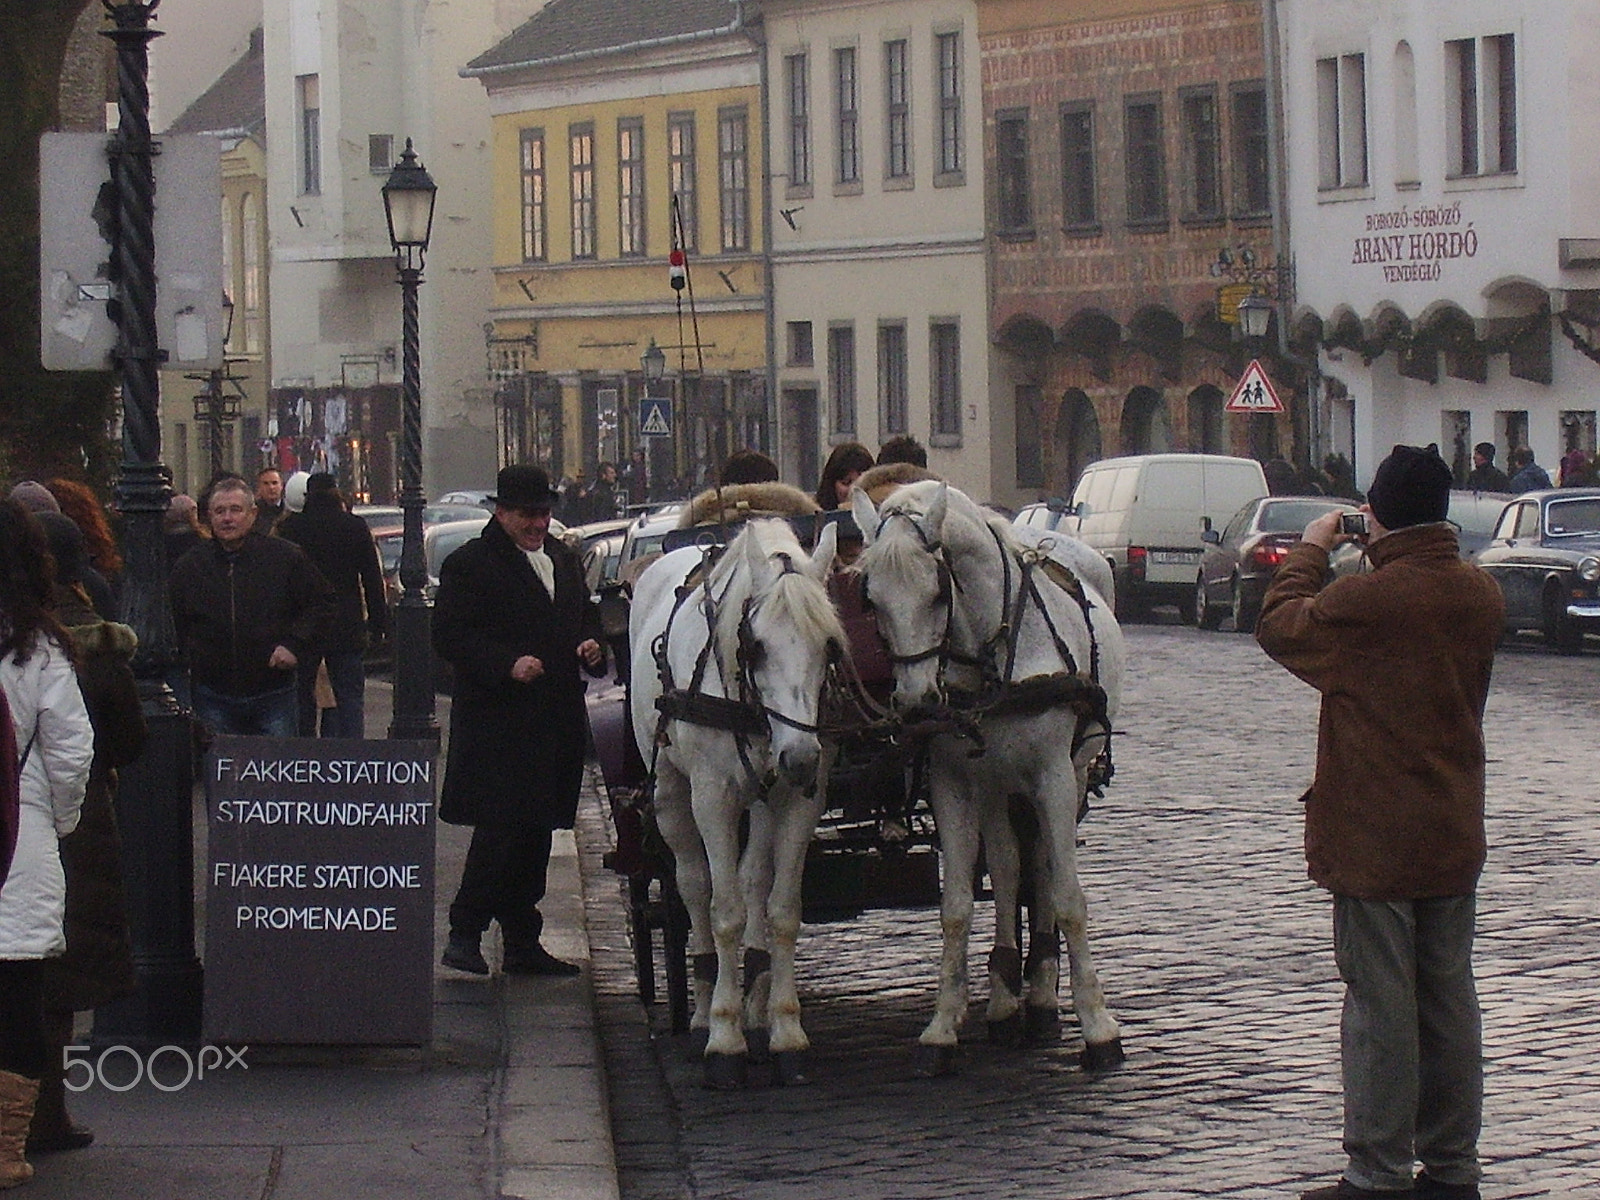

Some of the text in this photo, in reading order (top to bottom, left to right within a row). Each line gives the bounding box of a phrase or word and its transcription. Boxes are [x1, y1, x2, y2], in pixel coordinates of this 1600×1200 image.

[1352, 222, 1478, 264] ARANY HORDÓ
[216, 800, 433, 826] STADTRUNDFAHRT
[214, 863, 421, 889] FIAKERE STATIONE
[236, 905, 397, 931] PROMENADE
